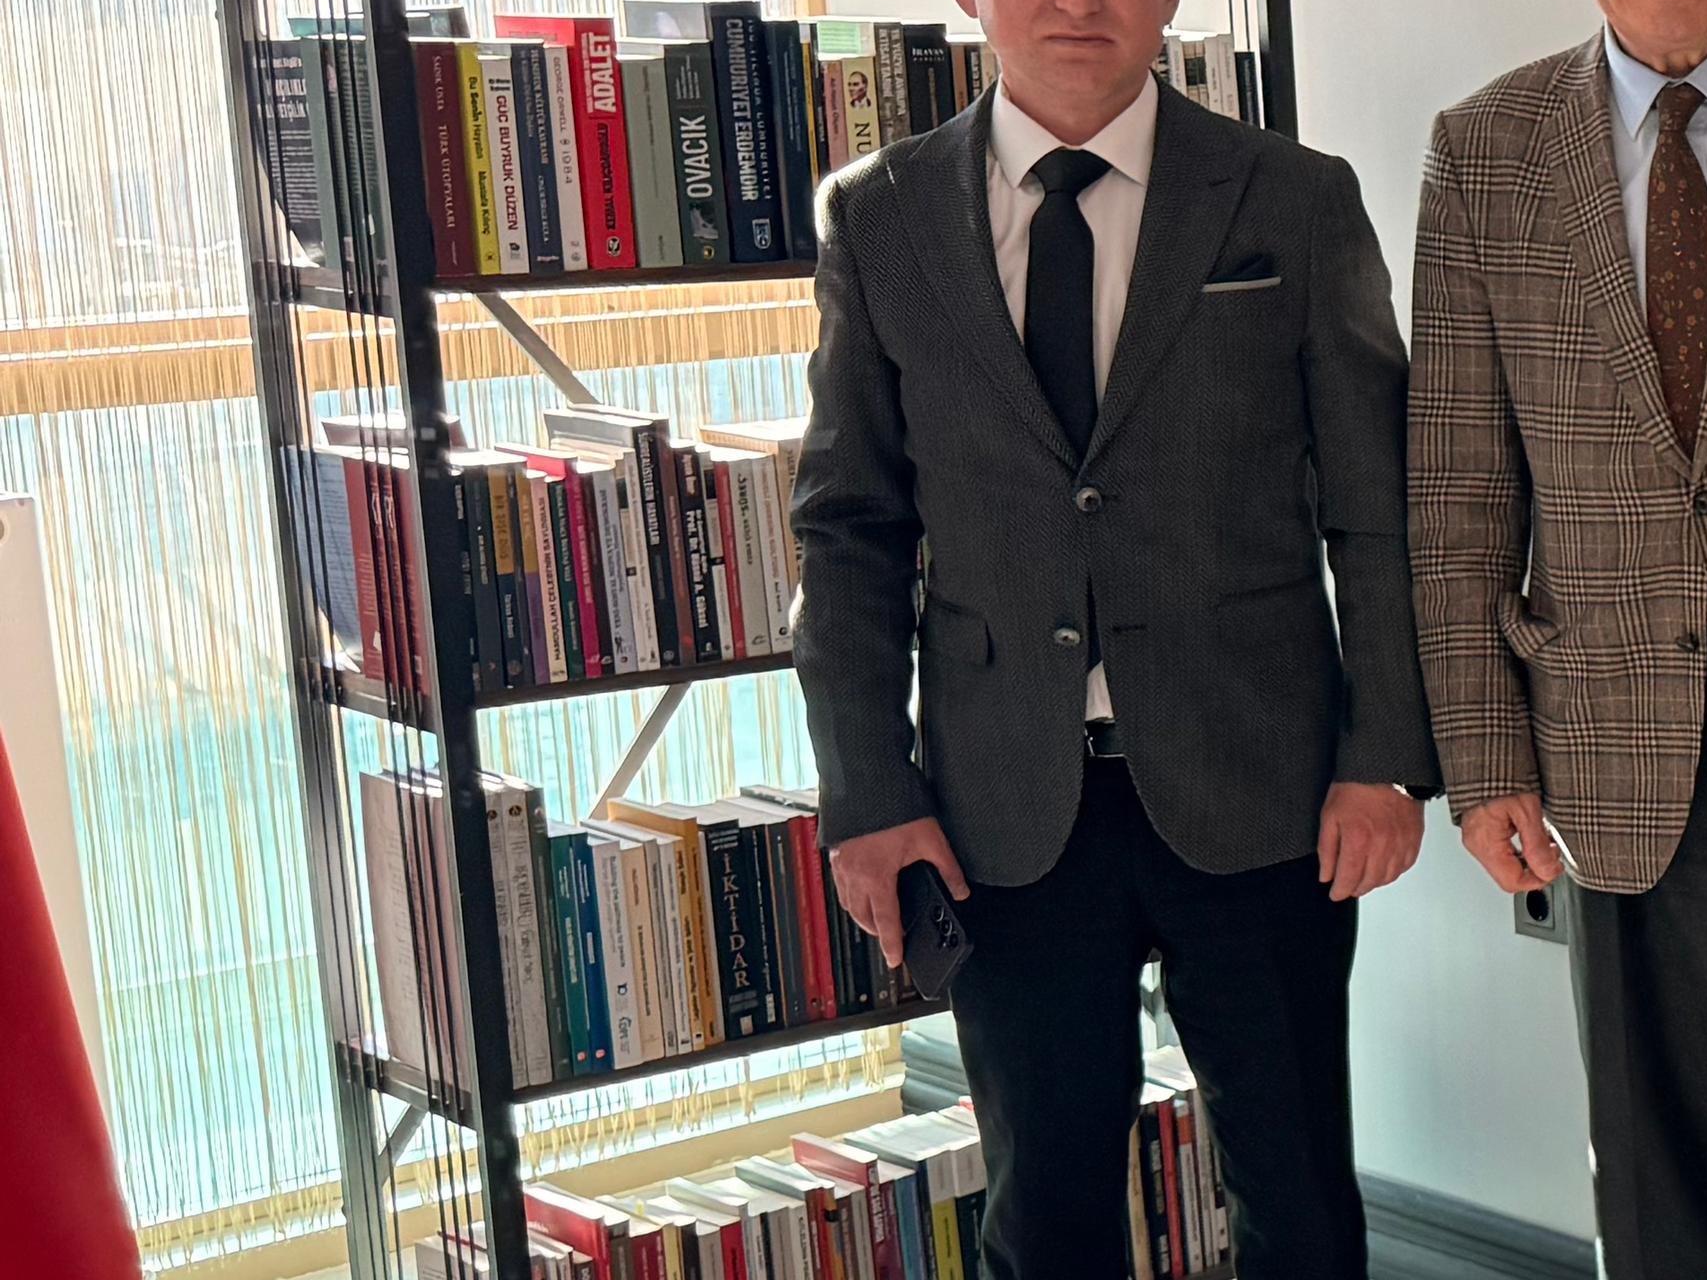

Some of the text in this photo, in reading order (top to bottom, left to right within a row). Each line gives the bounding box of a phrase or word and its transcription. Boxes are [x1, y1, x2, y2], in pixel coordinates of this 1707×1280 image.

[552, 56, 568, 132] GEORGE ORWELL
[591, 32, 617, 113] ADALET
[726, 18, 758, 201] CUMHURİYET ERDEMDİR
[438, 124, 450, 155] TÜRK
[494, 94, 520, 231] GÜÇ BUYRUK DÜZEN
[561, 149, 574, 184] 1984
[679, 115, 713, 199] OVACIK
[722, 853, 751, 988] İKTİDAR
